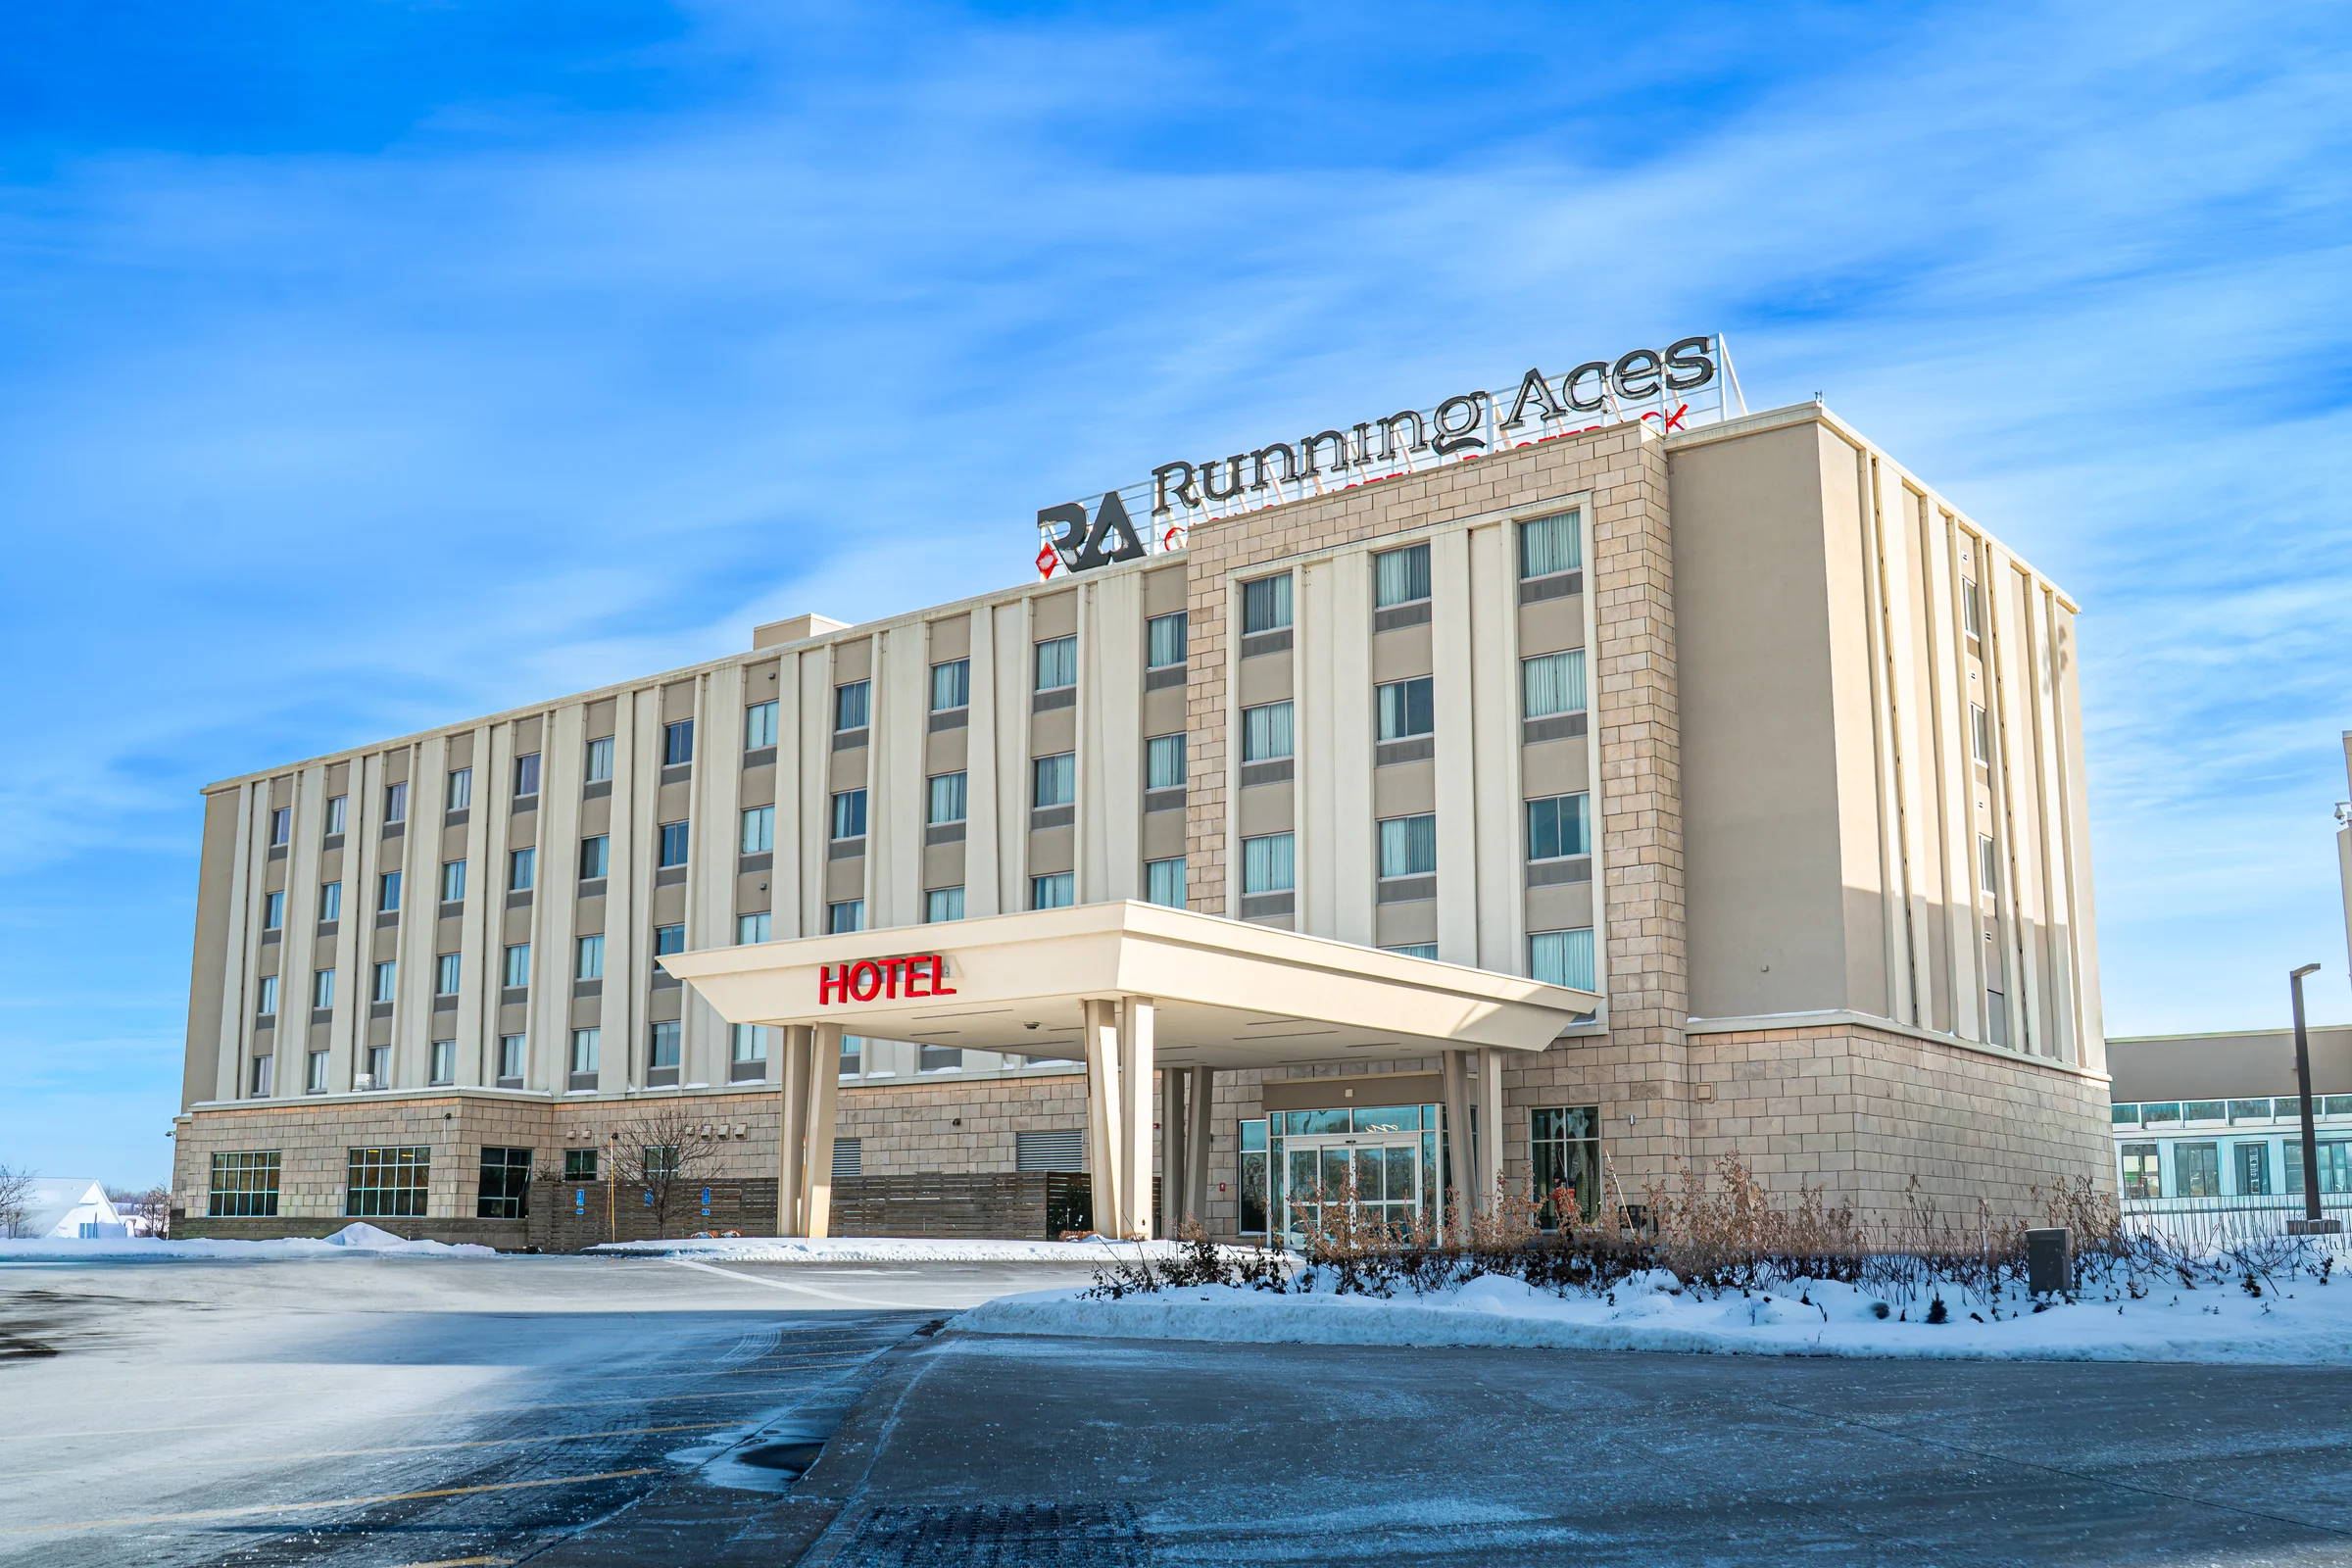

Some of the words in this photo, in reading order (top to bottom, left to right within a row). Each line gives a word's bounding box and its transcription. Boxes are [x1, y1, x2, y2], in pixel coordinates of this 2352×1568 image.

[1037, 490, 1147, 573] RA
[1152, 390, 1489, 516] Running
[1499, 336, 1714, 431] Aces
[819, 955, 956, 1004] HOTEL
